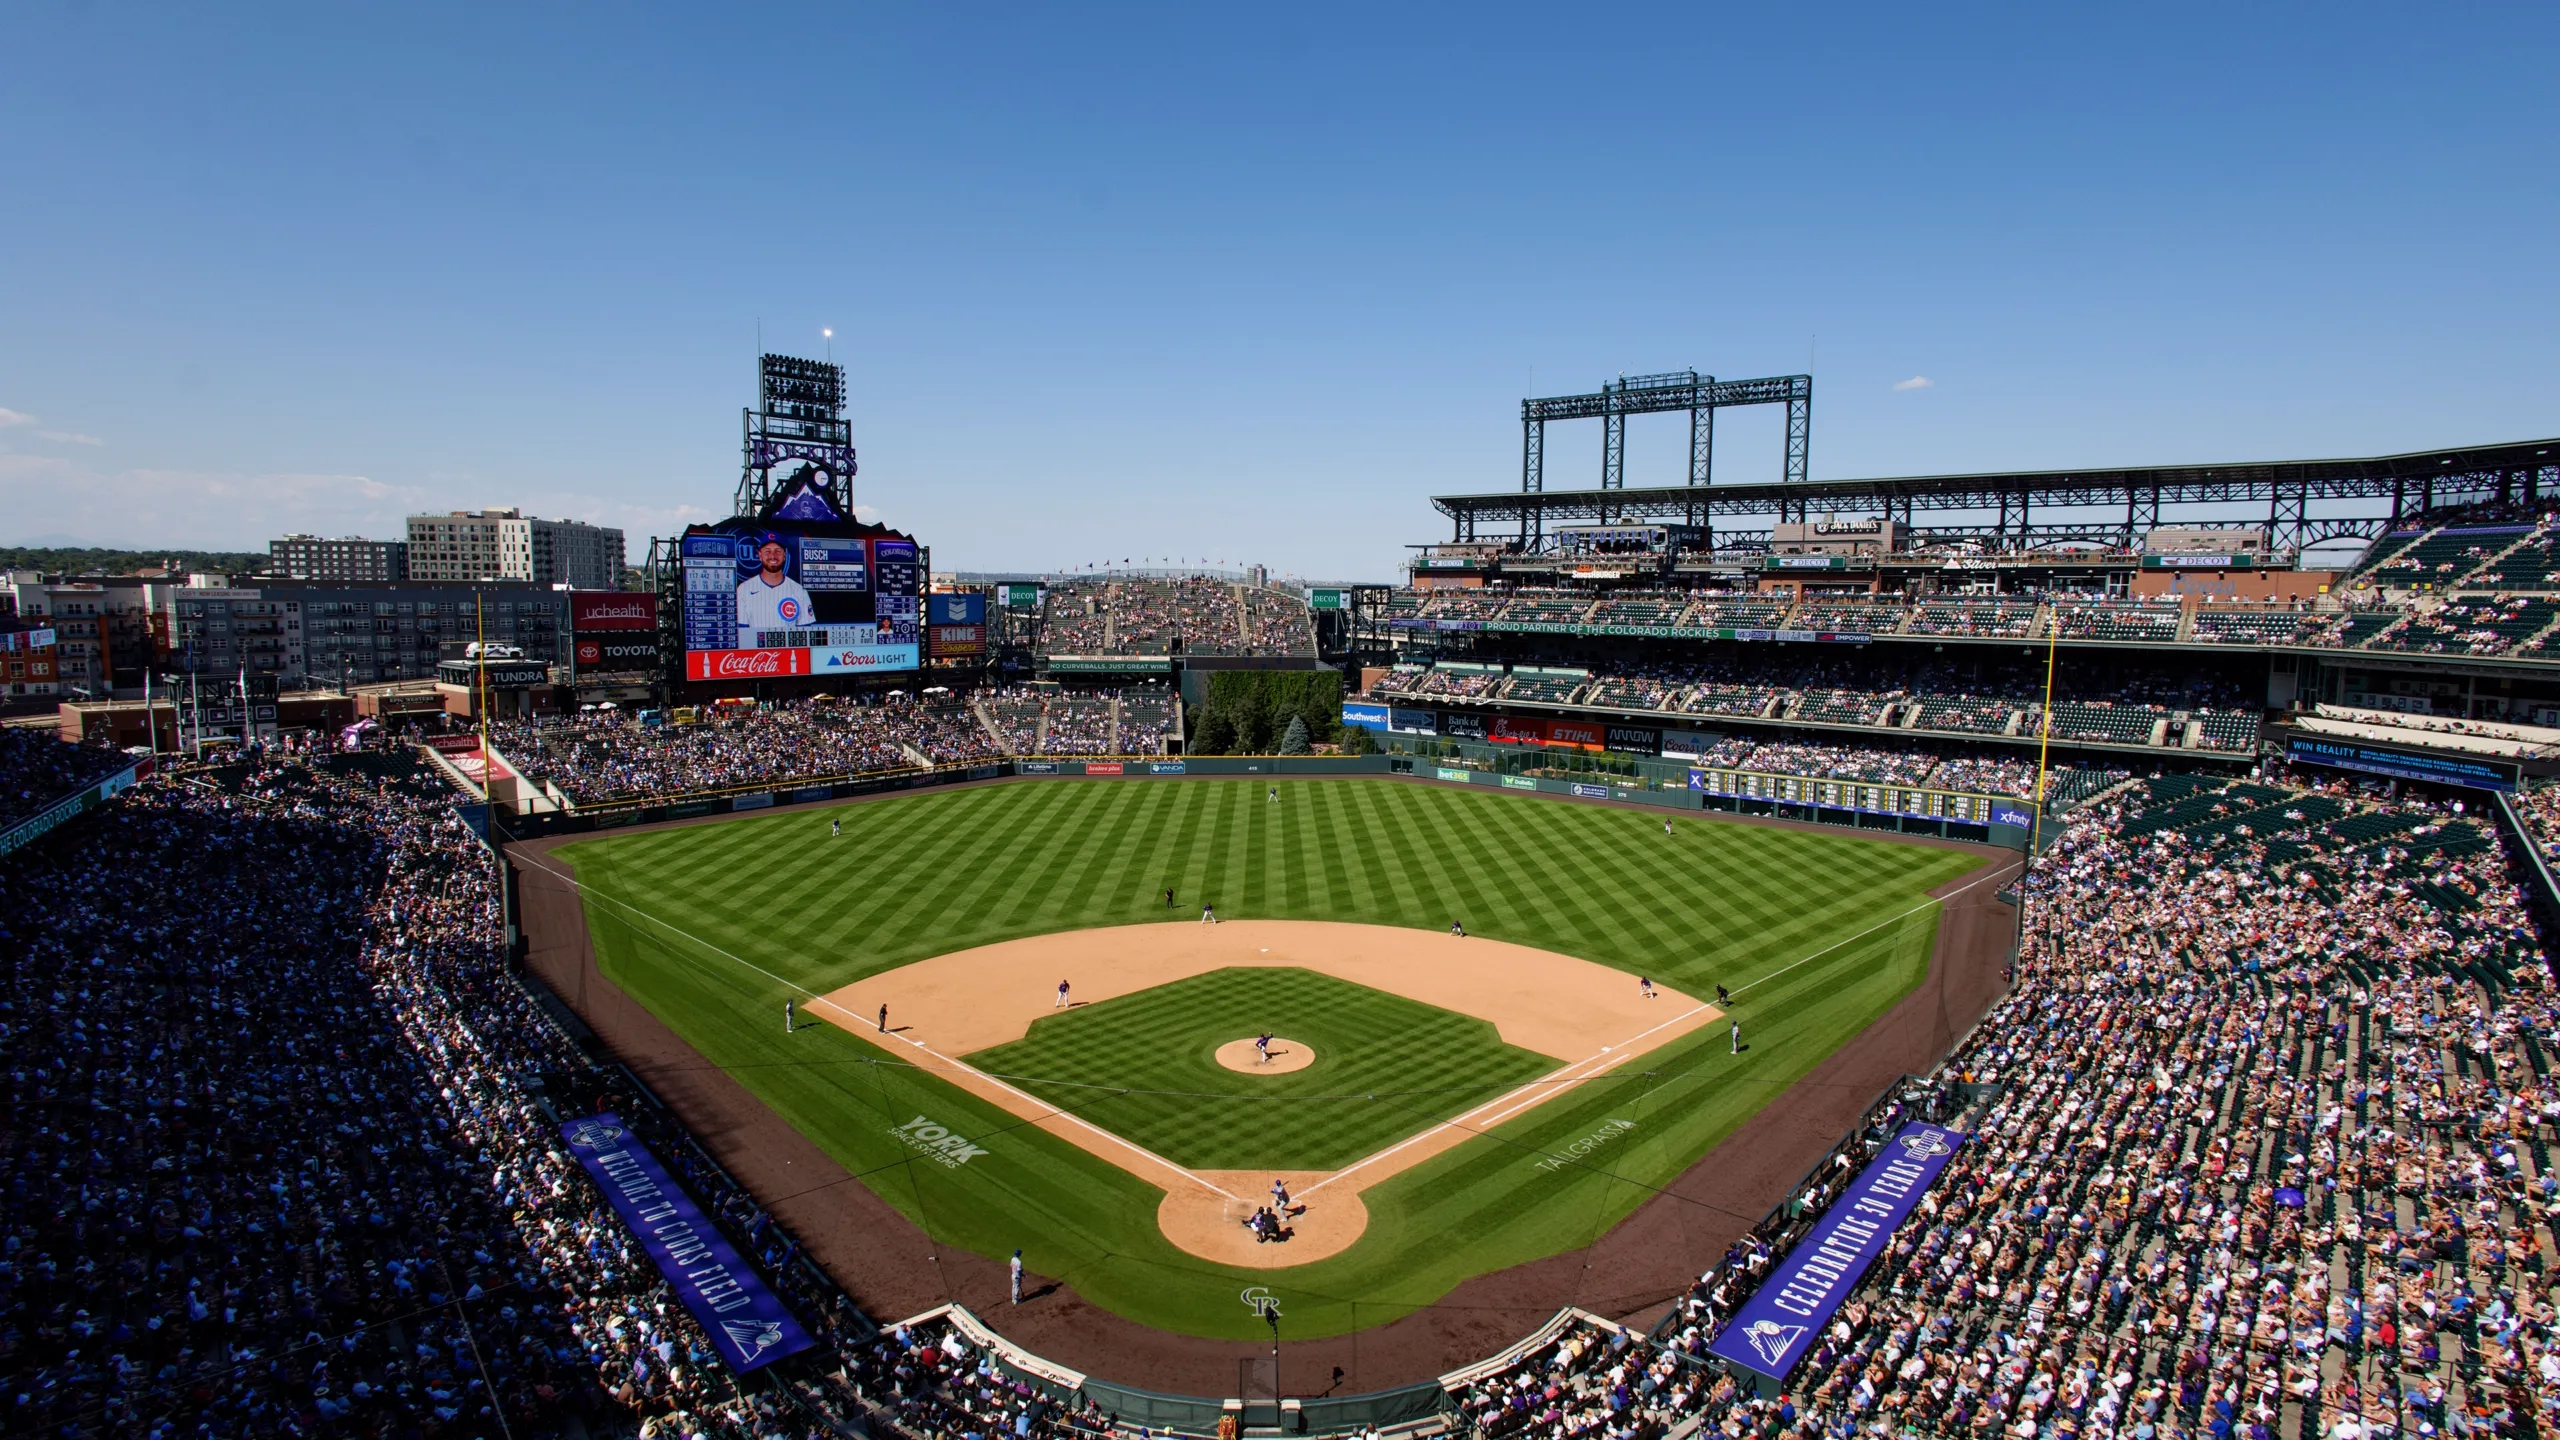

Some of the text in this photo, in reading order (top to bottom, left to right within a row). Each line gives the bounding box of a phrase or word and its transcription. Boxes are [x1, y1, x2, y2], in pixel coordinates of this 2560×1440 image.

[751, 439, 858, 475] ROCKIES
[804, 550, 828, 560] BUSCH
[880, 548, 912, 558] COLORADO
[1798, 559, 1829, 567] DECOY
[2186, 557, 2228, 565] DECOY
[586, 603, 645, 618] uchealth
[860, 629, 874, 638] 2-0
[941, 628, 976, 641] KING
[1487, 623, 1520, 631] PROUD
[1523, 624, 1567, 632] PARTNER
[1569, 625, 1582, 633] OF
[1584, 625, 1605, 634] THE
[1608, 626, 1669, 636] COLORADO
[1671, 628, 1719, 638] ROCKIES
[604, 646, 657, 657] TOYOTA
[842, 651, 906, 666] Coors LIGHT
[719, 652, 780, 674] Coca-Cola
[492, 672, 544, 682] TUNDRA
[1342, 711, 1380, 723] Southwest
[1449, 716, 1479, 726] Bank of
[1449, 725, 1486, 736] Colorado
[1553, 729, 1596, 742] STIHL
[1664, 739, 1696, 753] Coors
[2293, 741, 2355, 757] WIN REALITY
[1439, 770, 1468, 781] bet365
[2000, 812, 2030, 827] xfinity
[0, 798, 83, 856] HE COLORADO ROCKIES
[900, 1115, 990, 1164] YORK
[887, 1128, 960, 1169] SPACE SYSTEMS
[1534, 1123, 1629, 1172] TALLGRASS
[598, 1150, 751, 1313] WELCOME TO COORS FIELD
[1774, 1159, 1925, 1317] CELEBRATING 30 YEARS
